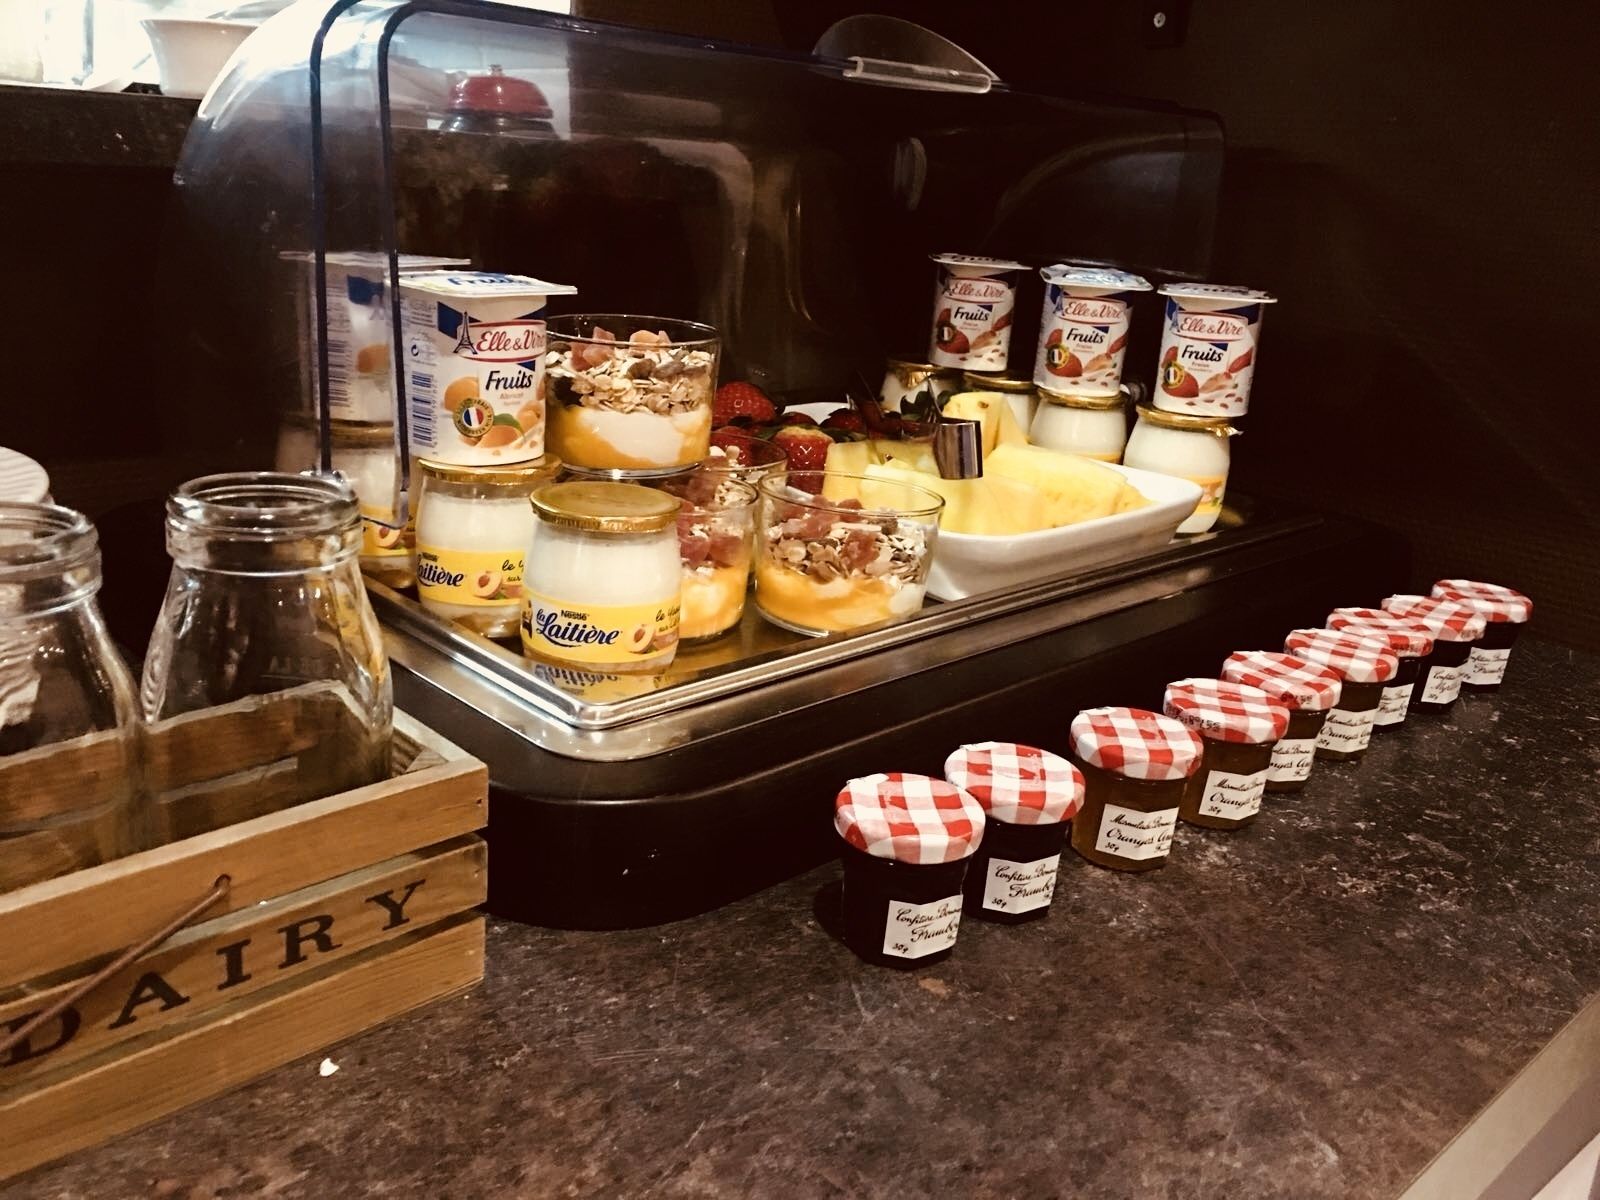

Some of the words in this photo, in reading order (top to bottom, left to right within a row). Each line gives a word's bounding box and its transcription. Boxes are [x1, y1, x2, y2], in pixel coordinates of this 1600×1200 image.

[954, 306, 990, 321] Fruits
[1065, 301, 1090, 317] Elle
[1066, 327, 1106, 344] Fruits
[1180, 316, 1206, 333] Elle
[1217, 320, 1244, 336] Vire
[477, 330, 511, 351] Elle
[513, 337, 523, 351] &
[1181, 344, 1224, 362] Fruits
[485, 369, 534, 391] Fruits
[536, 613, 620, 647] Laitière
[0, 878, 426, 1068] DAIRY
